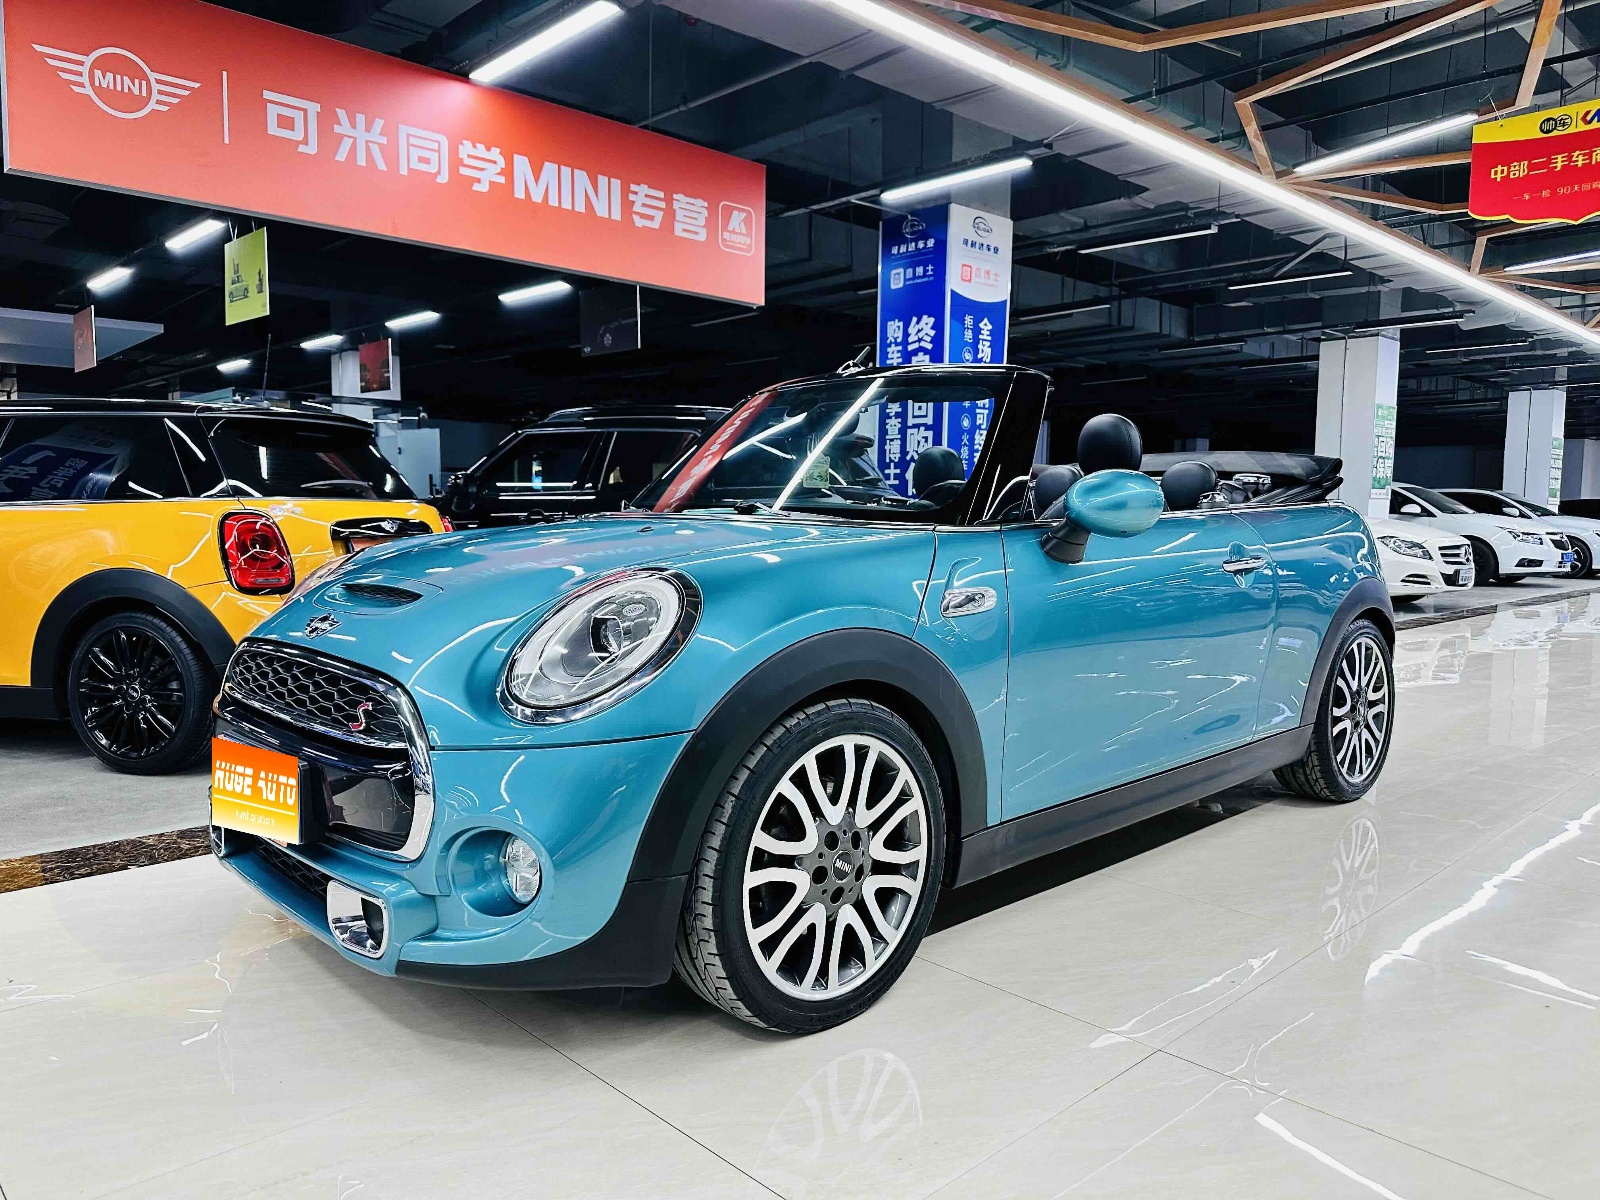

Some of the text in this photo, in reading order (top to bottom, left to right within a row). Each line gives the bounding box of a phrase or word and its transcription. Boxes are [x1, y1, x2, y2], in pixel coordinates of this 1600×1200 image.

[93, 69, 147, 97] MINI
[349, 701, 373, 731] S
[834, 858, 852, 874] MINI
